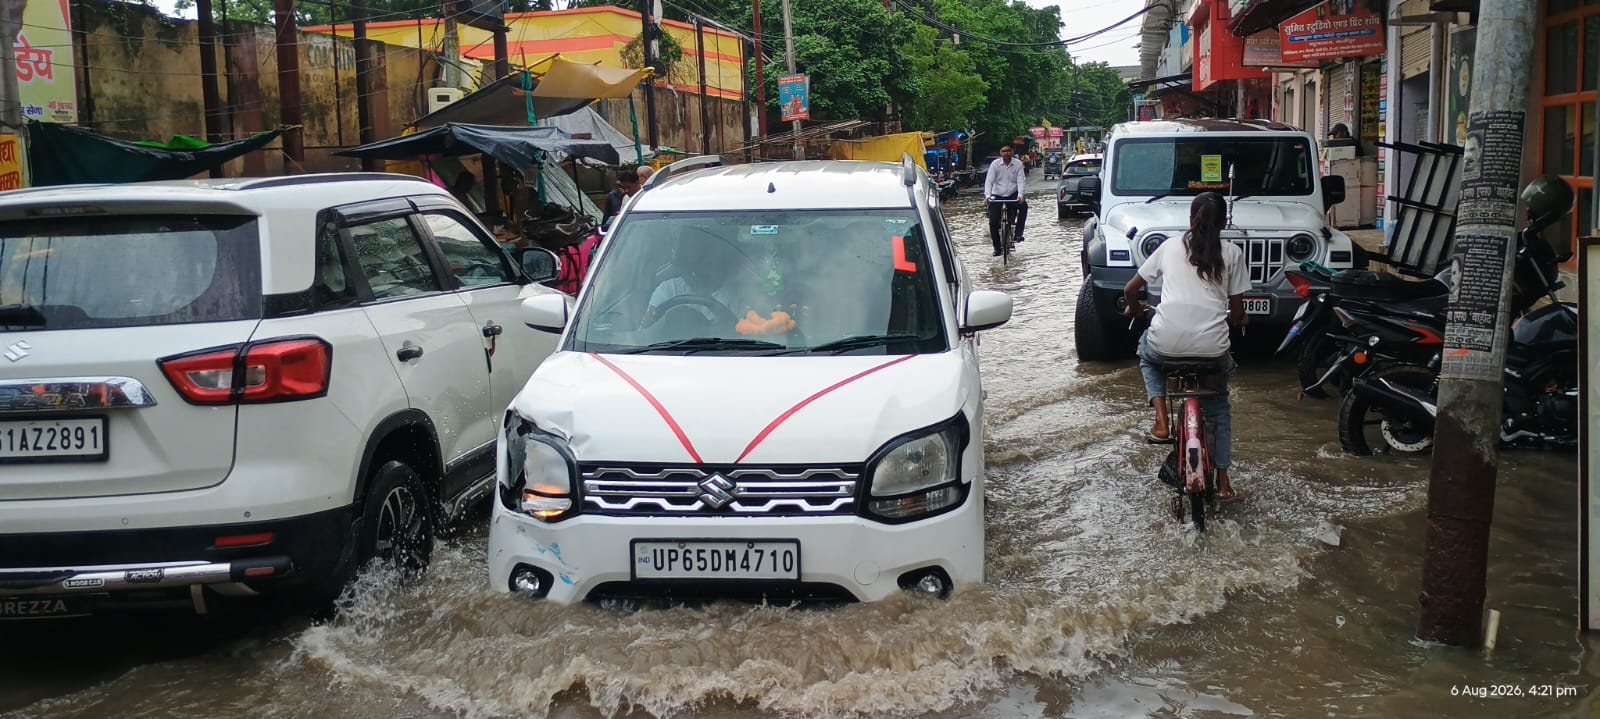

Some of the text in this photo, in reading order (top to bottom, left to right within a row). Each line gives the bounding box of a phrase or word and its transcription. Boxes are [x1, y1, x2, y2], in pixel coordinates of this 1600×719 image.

[1283, 22, 1305, 35] सुमित
[13, 33, 53, 82] डेय
[0, 426, 98, 452] 1AZ2891
[653, 548, 793, 572] UP65DM4710
[0, 600, 67, 616] REZZA
